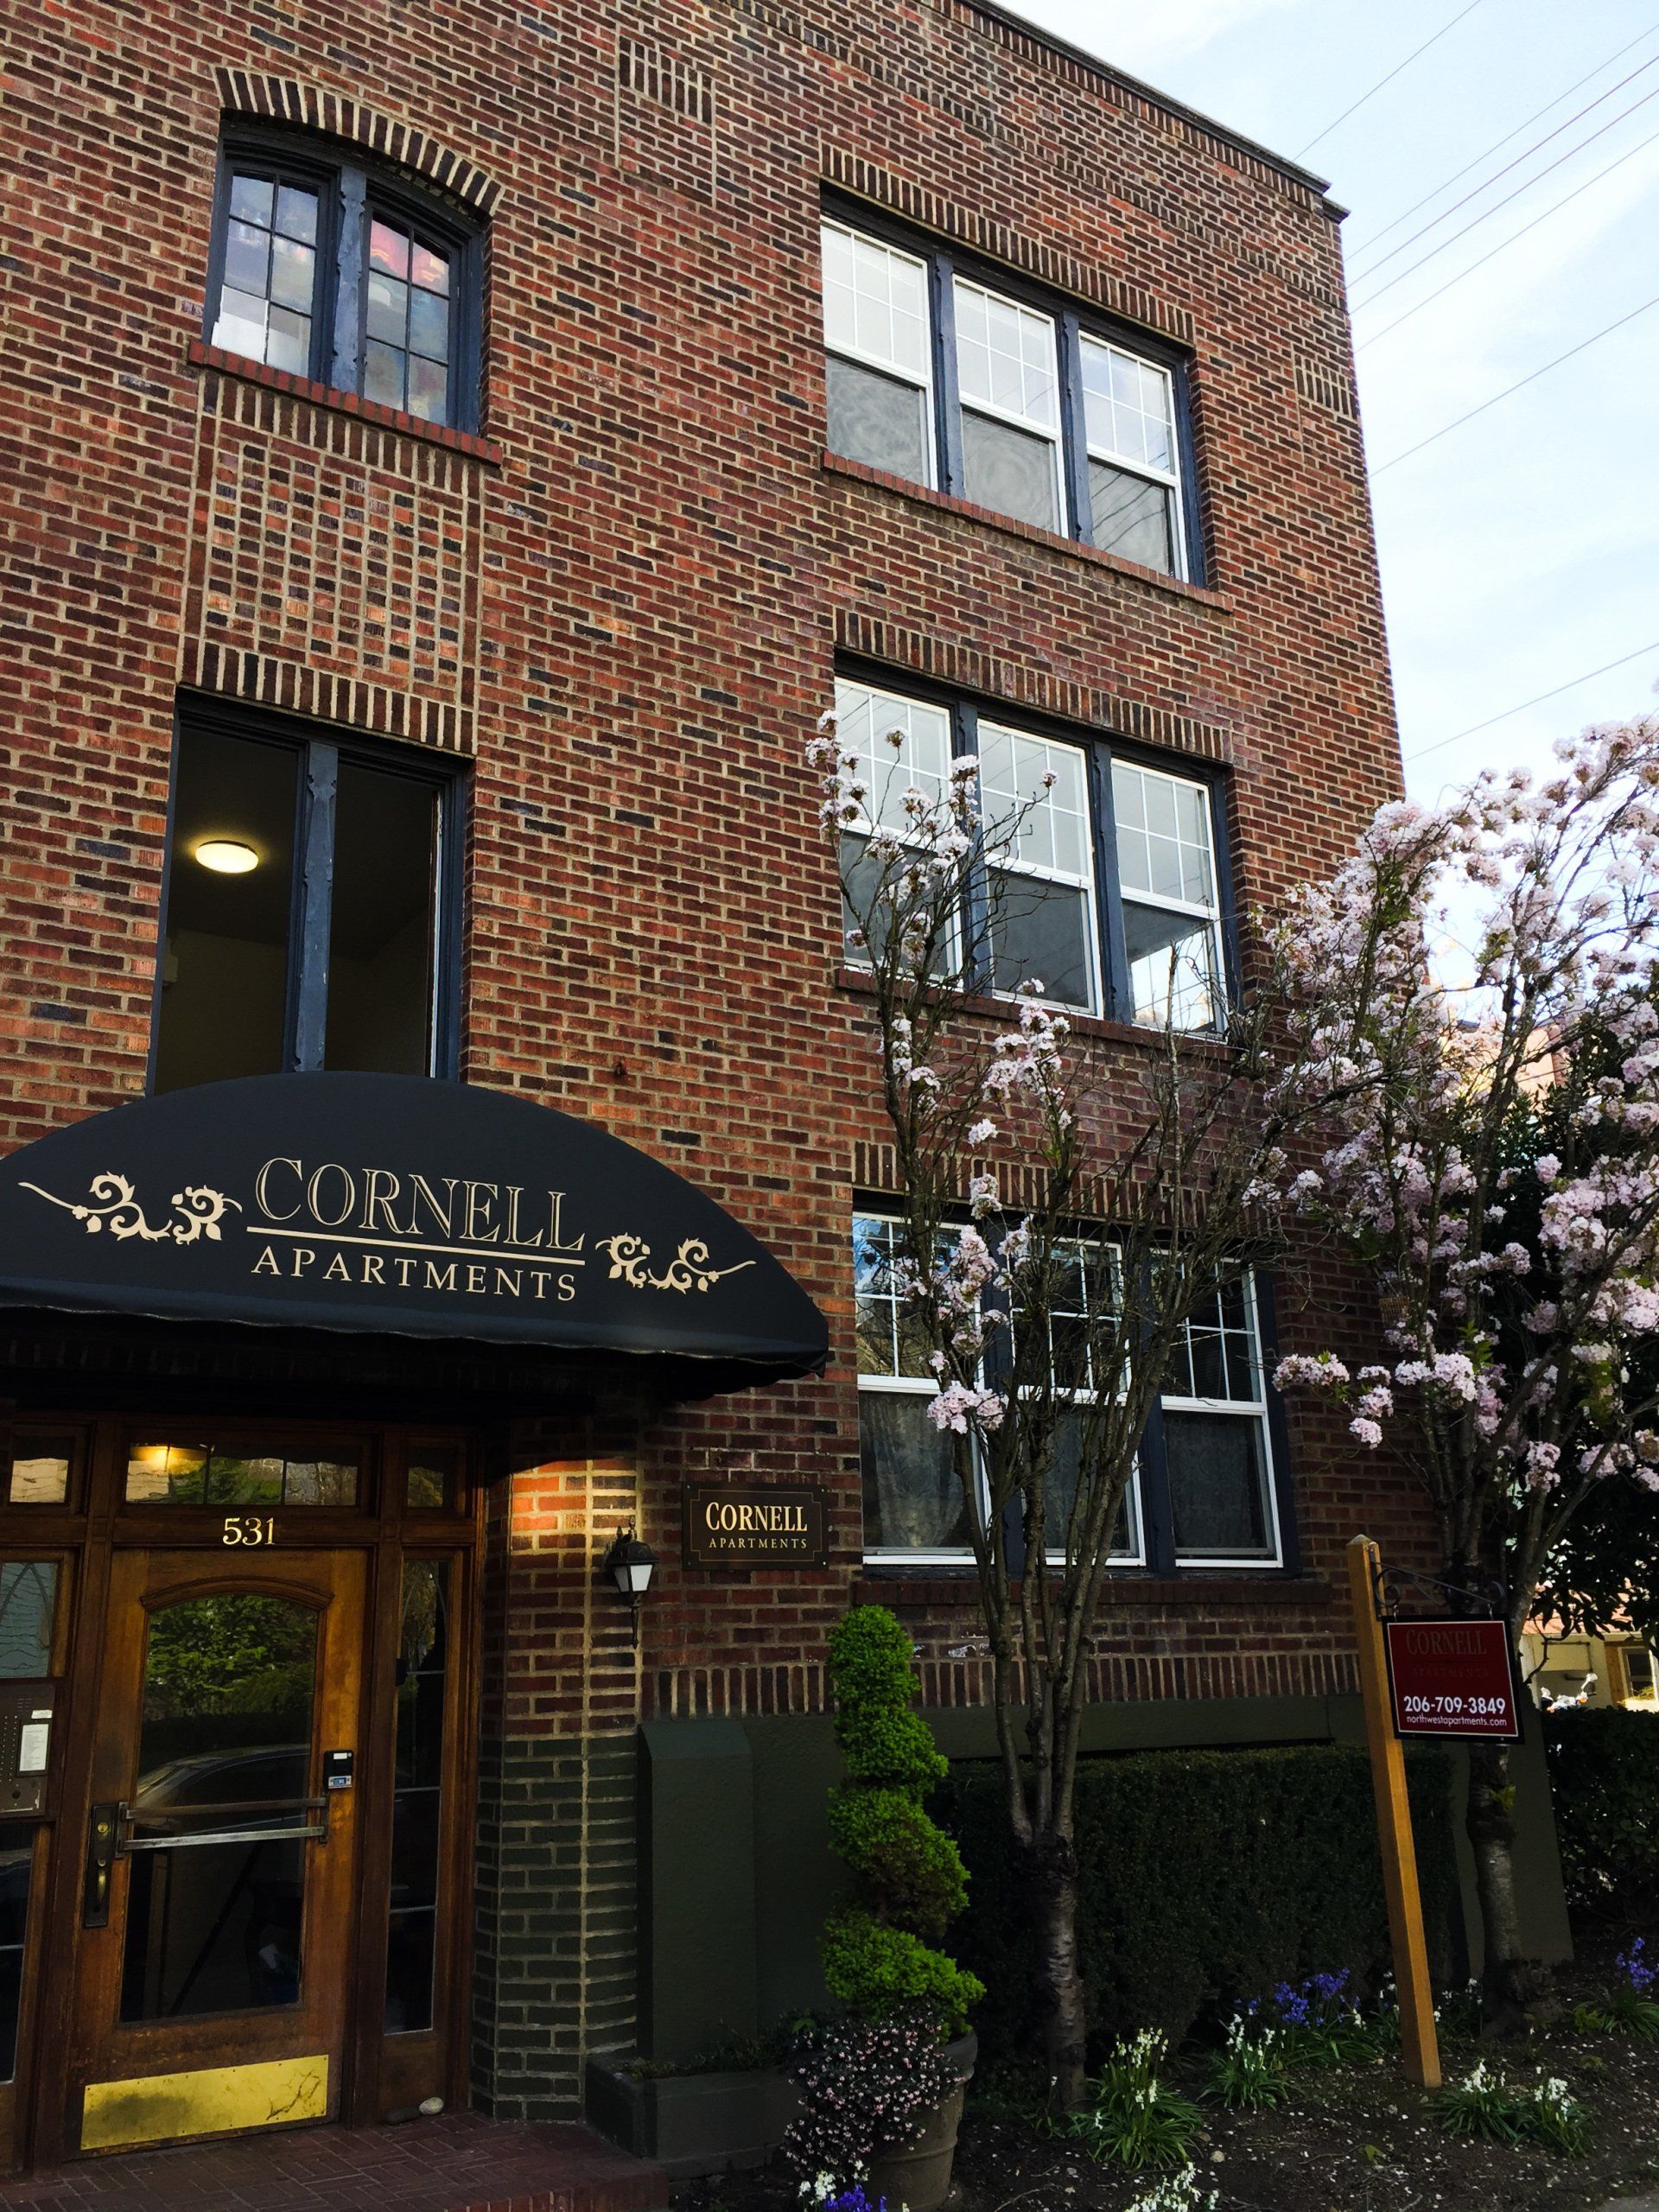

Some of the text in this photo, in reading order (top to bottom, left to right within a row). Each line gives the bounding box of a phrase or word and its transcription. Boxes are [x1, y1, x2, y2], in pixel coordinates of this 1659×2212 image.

[256, 1158, 585, 1251] CORNELL
[251, 1245, 576, 1301] APARTMENTS
[705, 1502, 808, 1531] CORNELL
[222, 1516, 275, 1546] 531
[709, 1537, 807, 1548] APARTMENTS
[1406, 1629, 1487, 1655] CORNELL
[1403, 1695, 1506, 1714] 206-709-3849
[1407, 1713, 1507, 1727] northwestapartments.com
